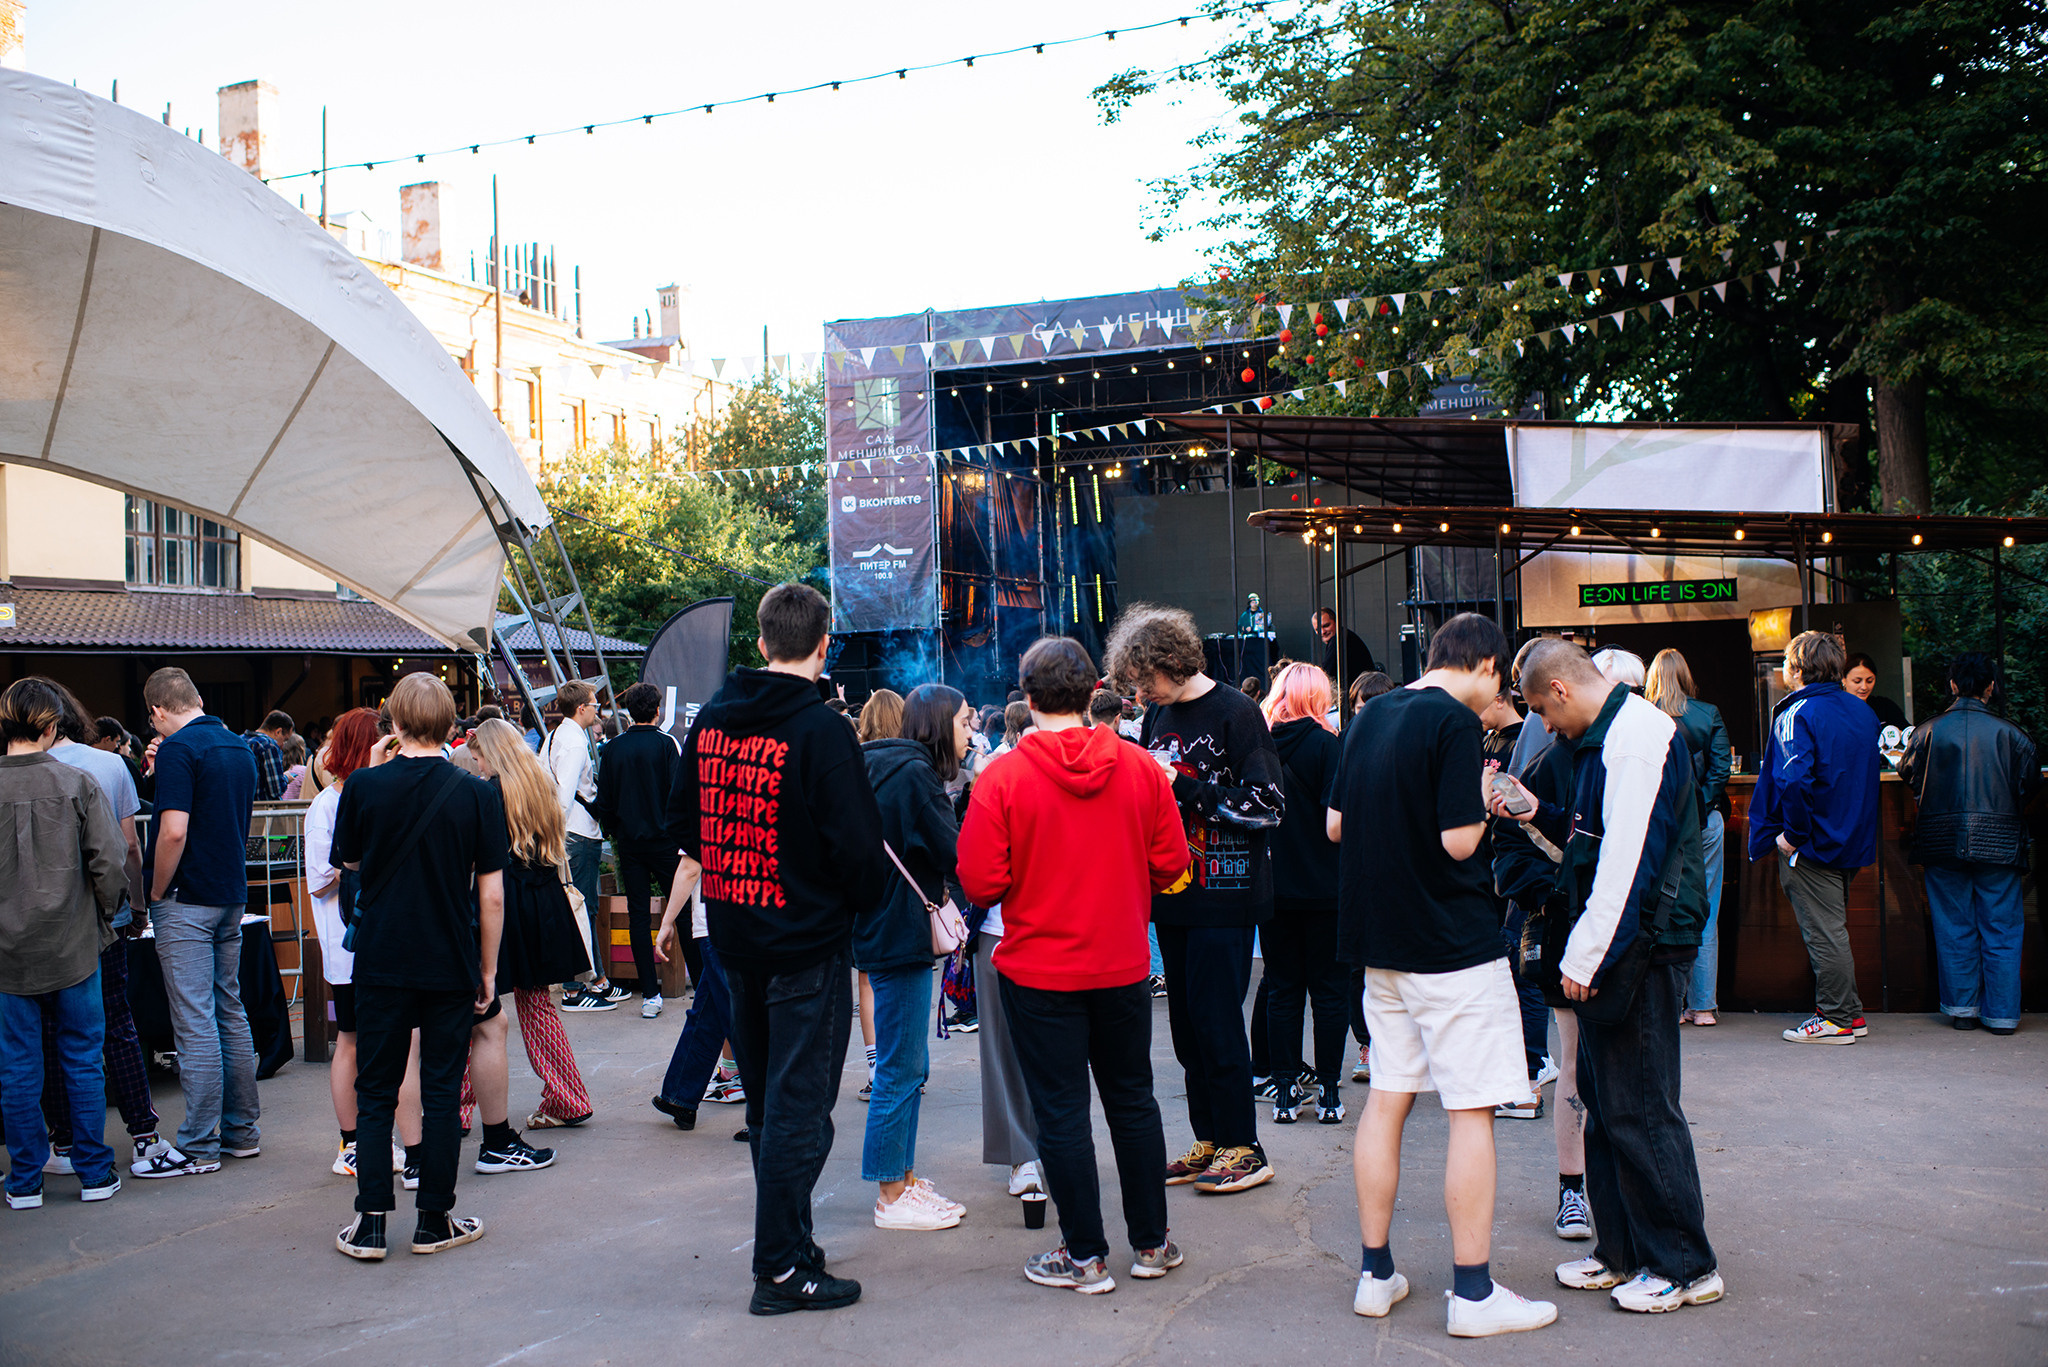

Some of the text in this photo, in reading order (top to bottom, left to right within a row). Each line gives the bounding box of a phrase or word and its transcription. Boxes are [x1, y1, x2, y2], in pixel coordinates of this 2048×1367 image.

[865, 435, 896, 445] САД
[837, 444, 921, 460] МЕНШИКОВА
[860, 560, 907, 571] ПИТЕР FM
[874, 572, 893, 580] 100.9
[1632, 584, 1671, 602] LIFE
[1679, 583, 1696, 600] IS
[1701, 582, 1732, 599] ON
[801, 1280, 819, 1295] N
